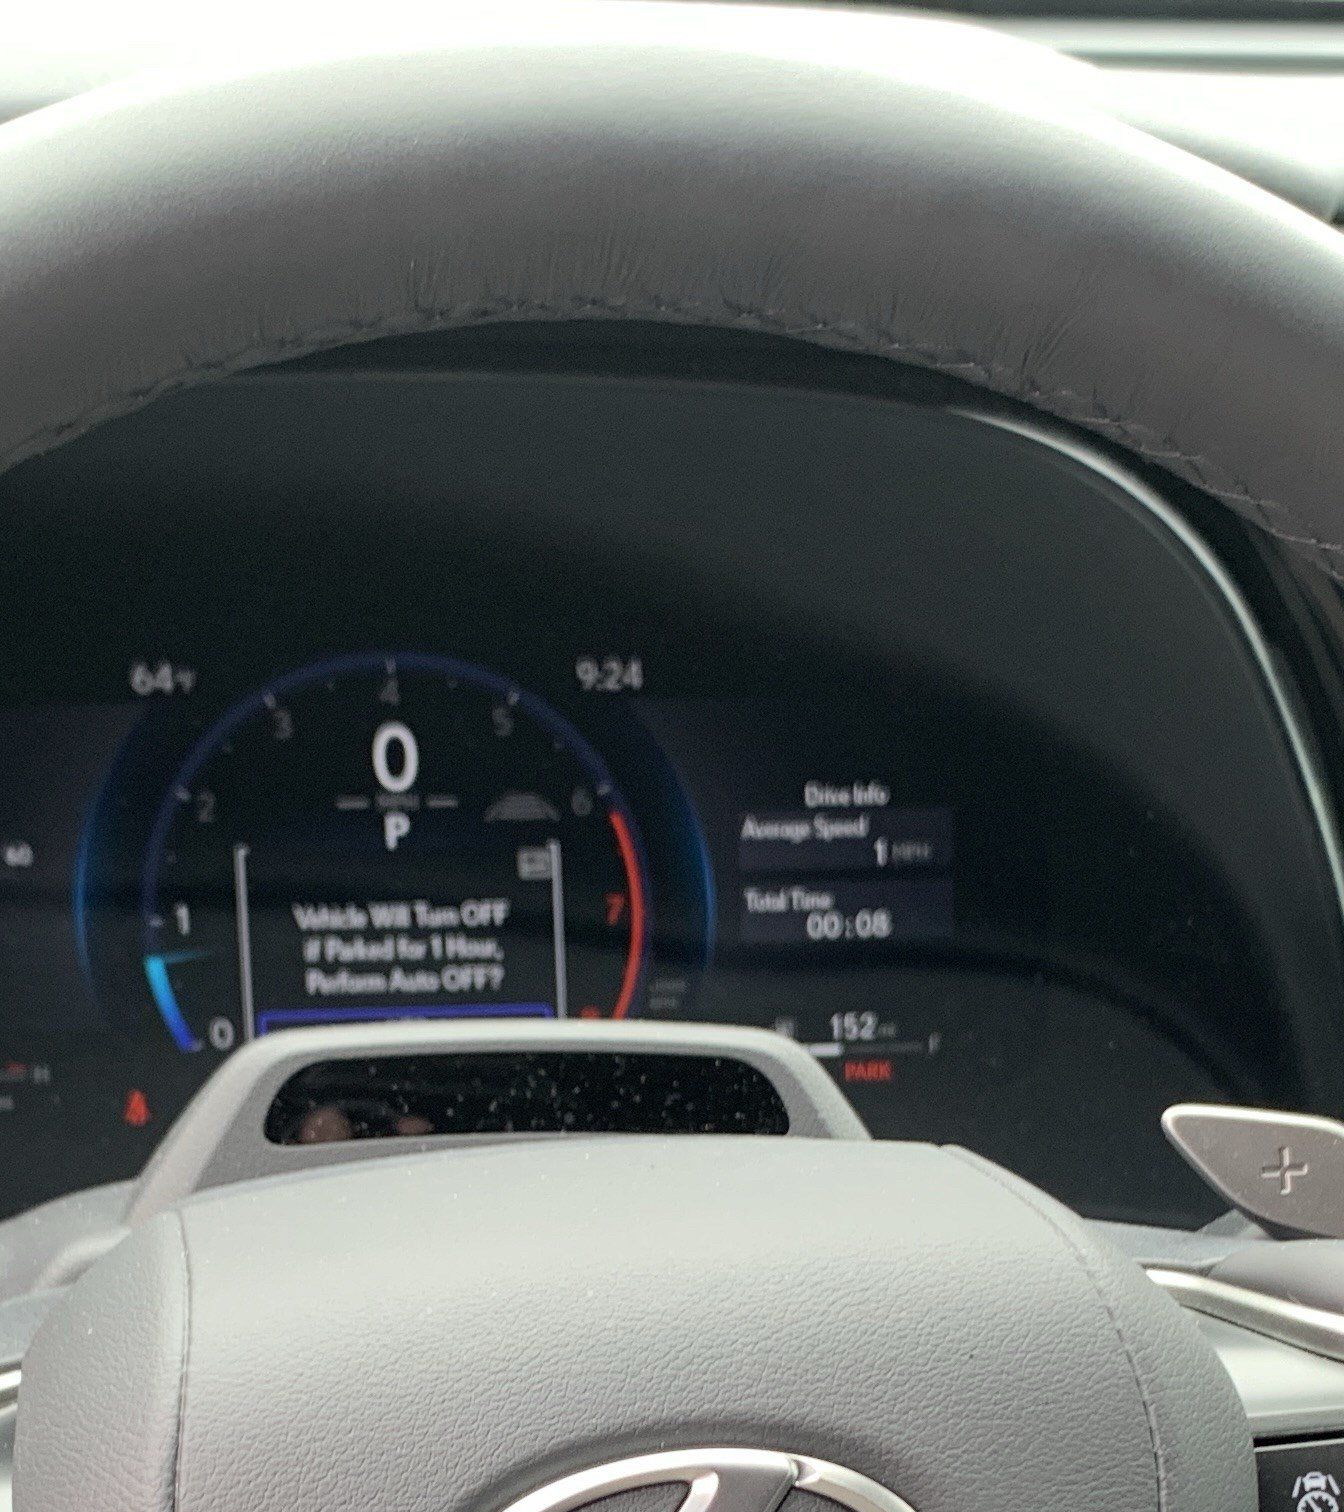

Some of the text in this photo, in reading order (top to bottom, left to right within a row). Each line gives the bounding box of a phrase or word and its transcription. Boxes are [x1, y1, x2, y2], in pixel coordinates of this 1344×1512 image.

[575, 655, 644, 691] 9:24
[372, 718, 419, 793] 0
[805, 779, 890, 808] Drive Info
[383, 811, 411, 851] P
[741, 812, 869, 843] Average Speed
[459, 898, 509, 927] OFF
[745, 884, 834, 912] Total Time
[175, 899, 191, 935] 1
[806, 909, 894, 940] 00:08
[440, 963, 506, 992] OFF?
[209, 1016, 236, 1051] 0
[830, 1010, 877, 1042] 152
[843, 1059, 893, 1083] PARK
